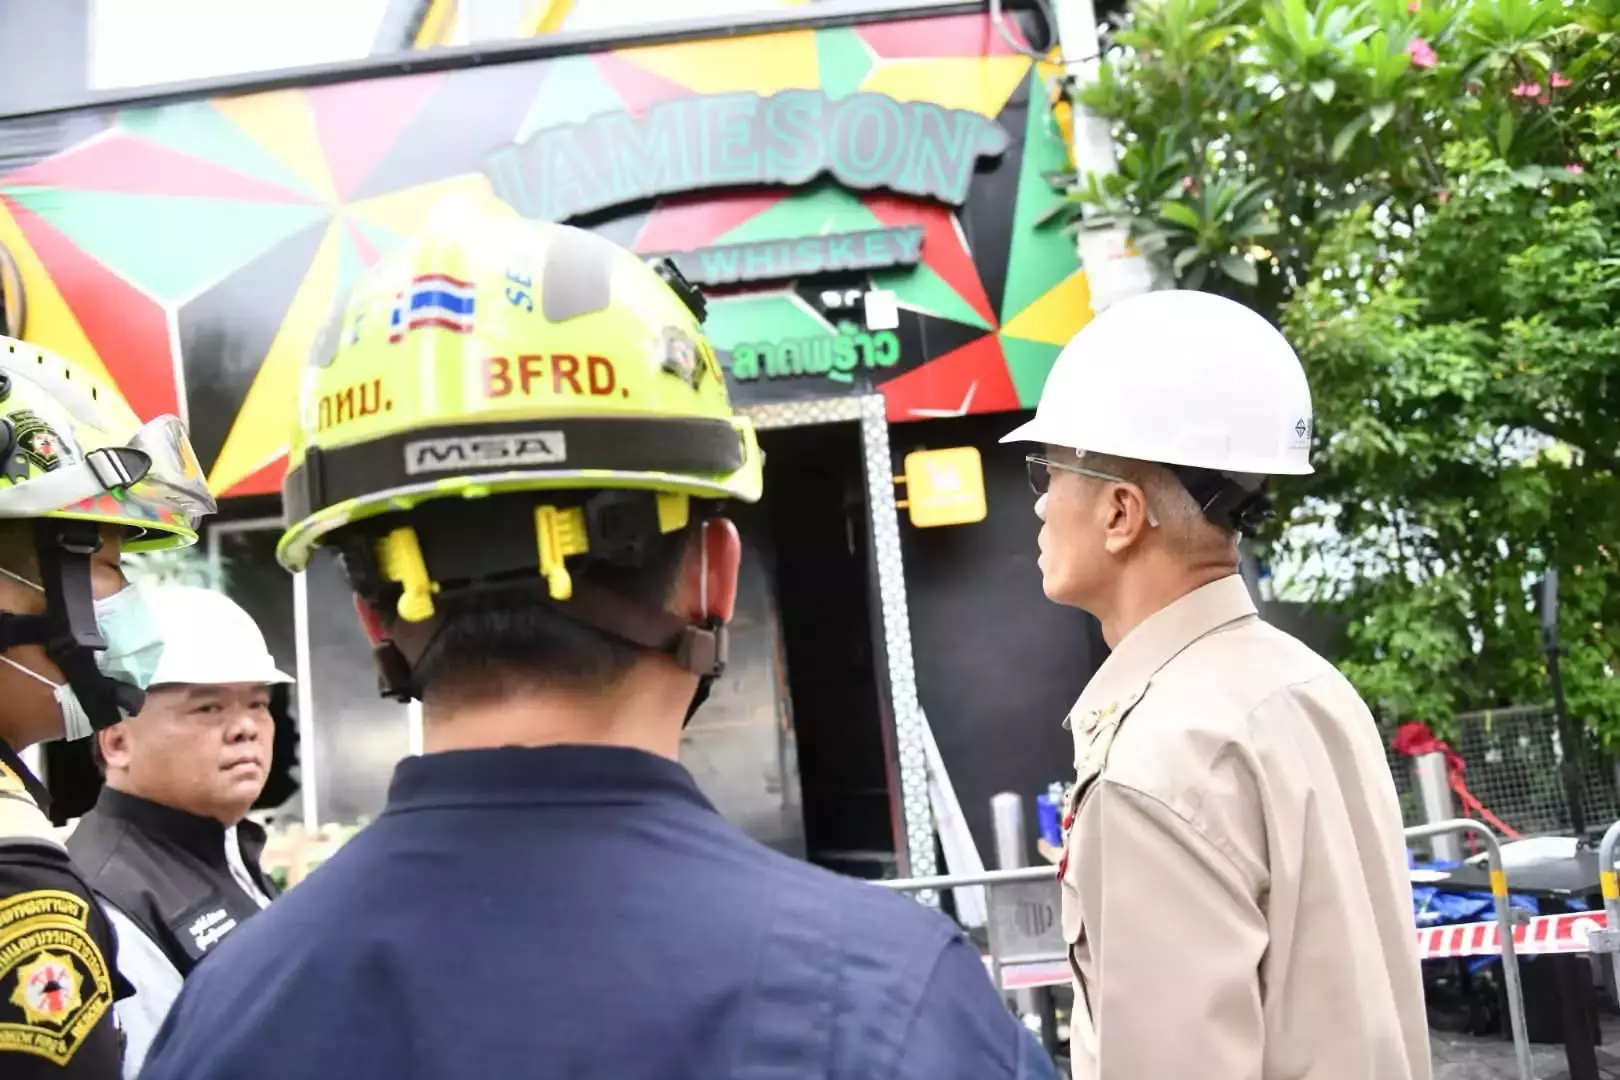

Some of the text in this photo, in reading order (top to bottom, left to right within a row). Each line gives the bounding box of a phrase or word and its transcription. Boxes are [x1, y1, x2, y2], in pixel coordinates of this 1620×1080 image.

[702, 230, 922, 279] WHISKEY
[484, 354, 629, 399] BFRD.
[416, 438, 554, 466] MSA
